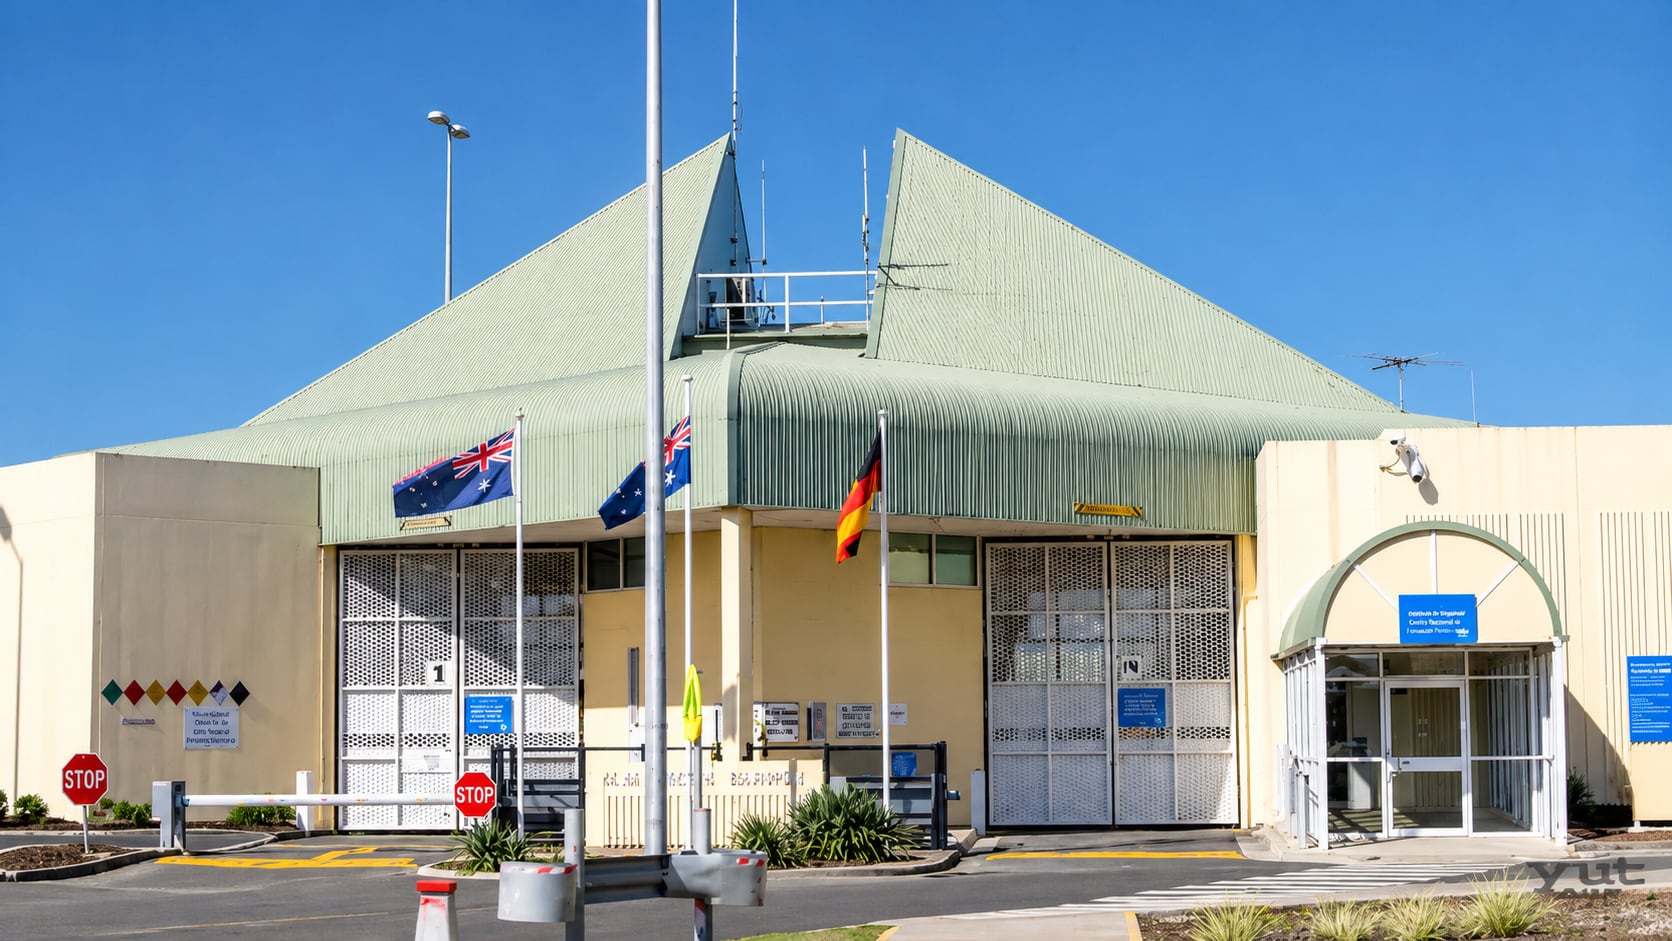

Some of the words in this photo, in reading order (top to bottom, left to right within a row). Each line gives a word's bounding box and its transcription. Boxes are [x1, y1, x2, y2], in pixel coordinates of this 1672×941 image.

[433, 664, 445, 682] 1
[65, 769, 105, 789] STOP
[456, 786, 494, 804] STOP
